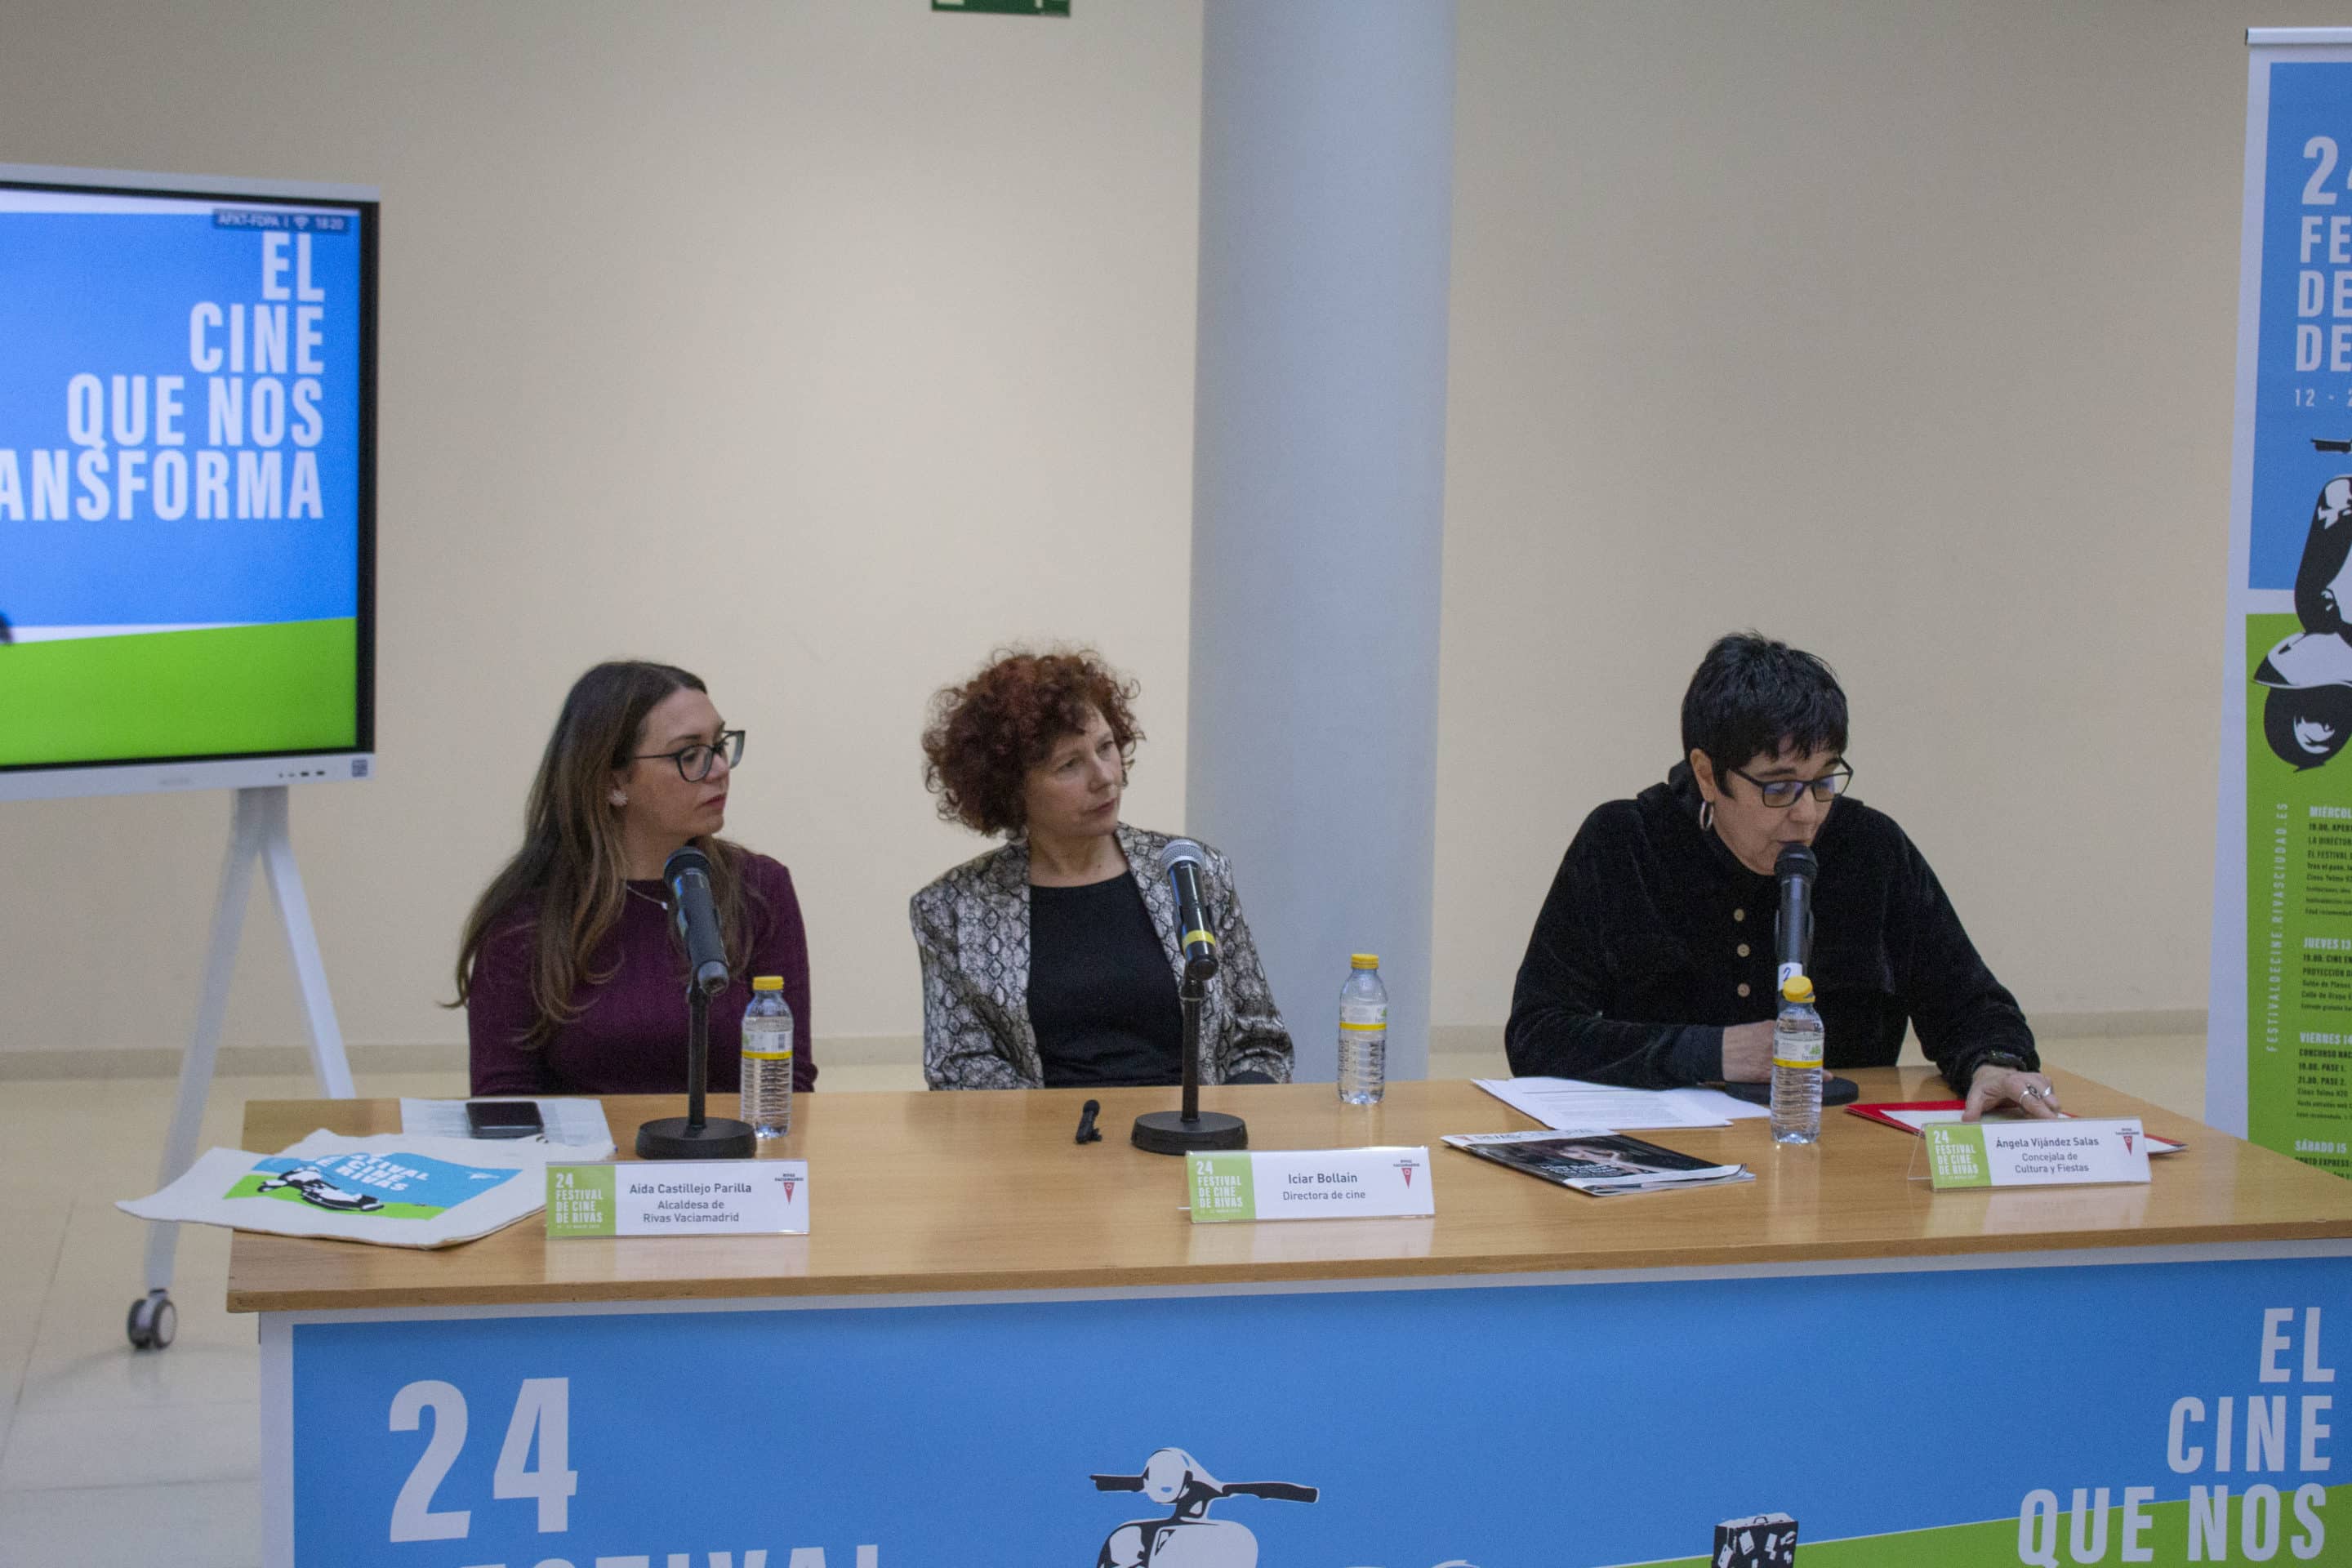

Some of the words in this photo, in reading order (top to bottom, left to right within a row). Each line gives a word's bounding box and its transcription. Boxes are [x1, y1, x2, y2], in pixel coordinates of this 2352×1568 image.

[2301, 136, 2352, 205] 2
[261, 231, 325, 302] EL
[2297, 270, 2352, 318] DE
[189, 301, 325, 375] CINE
[2296, 324, 2352, 372] DE
[2295, 388, 2315, 407] 12
[67, 373, 186, 451] QUE
[208, 377, 324, 448] NOS
[2300, 1032, 2340, 1045] VIERNES
[1934, 1130, 1949, 1144] 24
[1996, 1137, 2029, 1149] Ángela
[2073, 1137, 2100, 1146] Salas
[1936, 1144, 1976, 1155] FESTIVAL
[2295, 1139, 2333, 1154] SÁBADO
[1951, 1154, 1971, 1164] CINE
[2022, 1152, 2065, 1162] Concejala
[1196, 1160, 1214, 1175] 24
[1953, 1164, 1978, 1174] RIVAS
[2016, 1164, 2048, 1174] Cultura
[2058, 1164, 2089, 1172] Fiestas
[556, 1172, 573, 1188] 24
[1197, 1176, 1242, 1187] FESTIVAL
[556, 1189, 603, 1200] FESTIVAL
[630, 1184, 654, 1194] Aida
[657, 1183, 710, 1196] Castillejo
[715, 1183, 751, 1193] Parilla
[1199, 1187, 1211, 1197] DE
[1214, 1186, 1236, 1197] CINE
[1283, 1191, 1329, 1200] Directora
[1331, 1190, 1343, 1200] de
[1345, 1190, 1365, 1199] cine
[556, 1200, 568, 1211] DE
[572, 1200, 595, 1211] CINE
[657, 1200, 709, 1209] Alcaldesa
[712, 1200, 724, 1209] de
[1200, 1198, 1212, 1208] DE
[1214, 1196, 1242, 1208] RIVAS
[556, 1212, 568, 1223] DE
[572, 1212, 602, 1223] RIVAS
[644, 1214, 671, 1223] Rivas
[674, 1212, 739, 1223] Vaciamadrid
[2259, 1307, 2335, 1383] EL
[2167, 1396, 2332, 1473] CINE
[390, 1377, 577, 1543] 24
[2018, 1486, 2156, 1568] QUE
[2187, 1482, 2328, 1562] NOS
